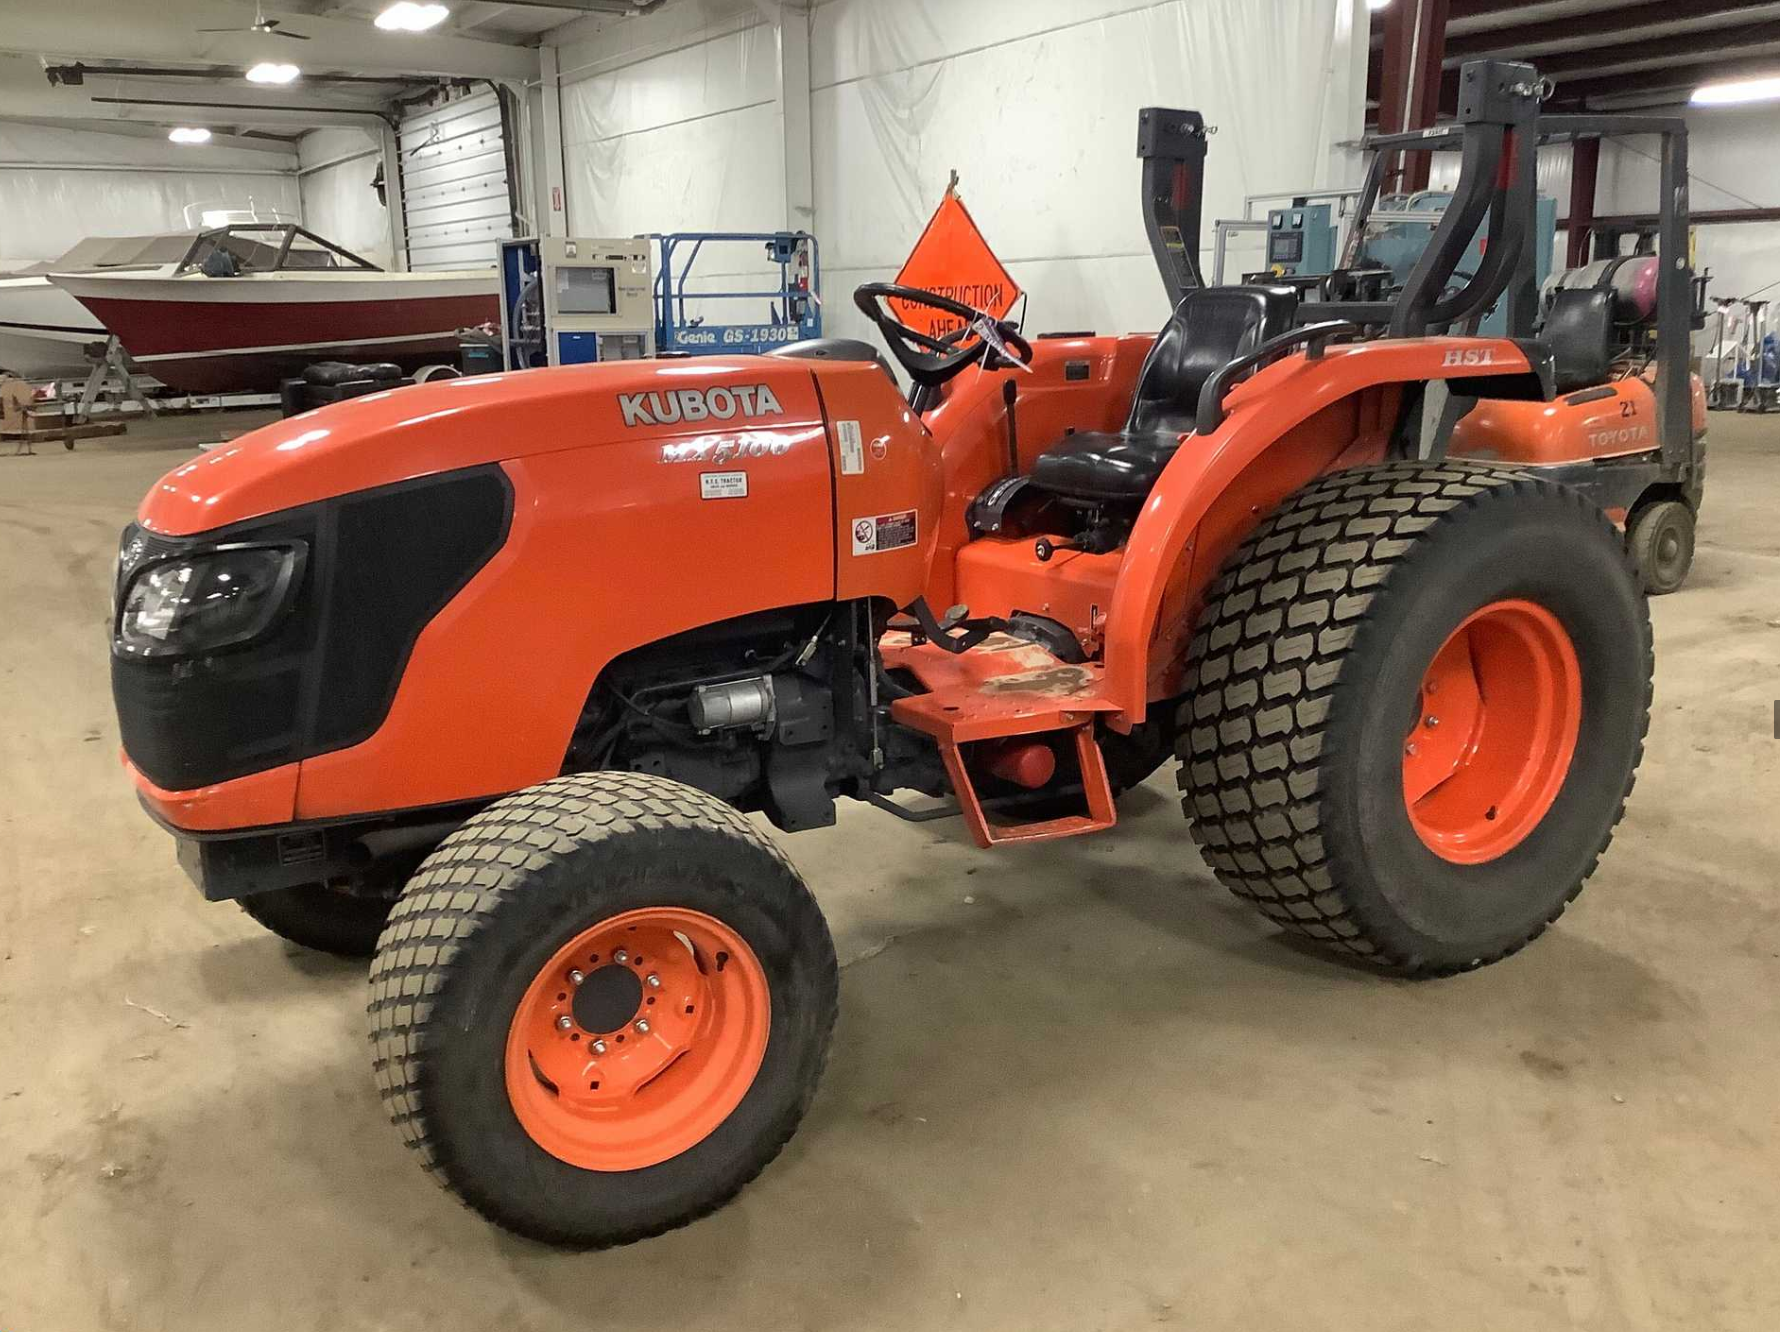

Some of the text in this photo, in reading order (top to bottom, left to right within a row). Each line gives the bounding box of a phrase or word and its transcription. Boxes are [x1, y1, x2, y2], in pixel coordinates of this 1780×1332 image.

[676, 328, 787, 344] Genie GS-1930
[1442, 347, 1494, 366] HST
[618, 384, 784, 426] KUBOTA
[1619, 400, 1637, 418] 21
[1589, 427, 1648, 446] TOYOTA
